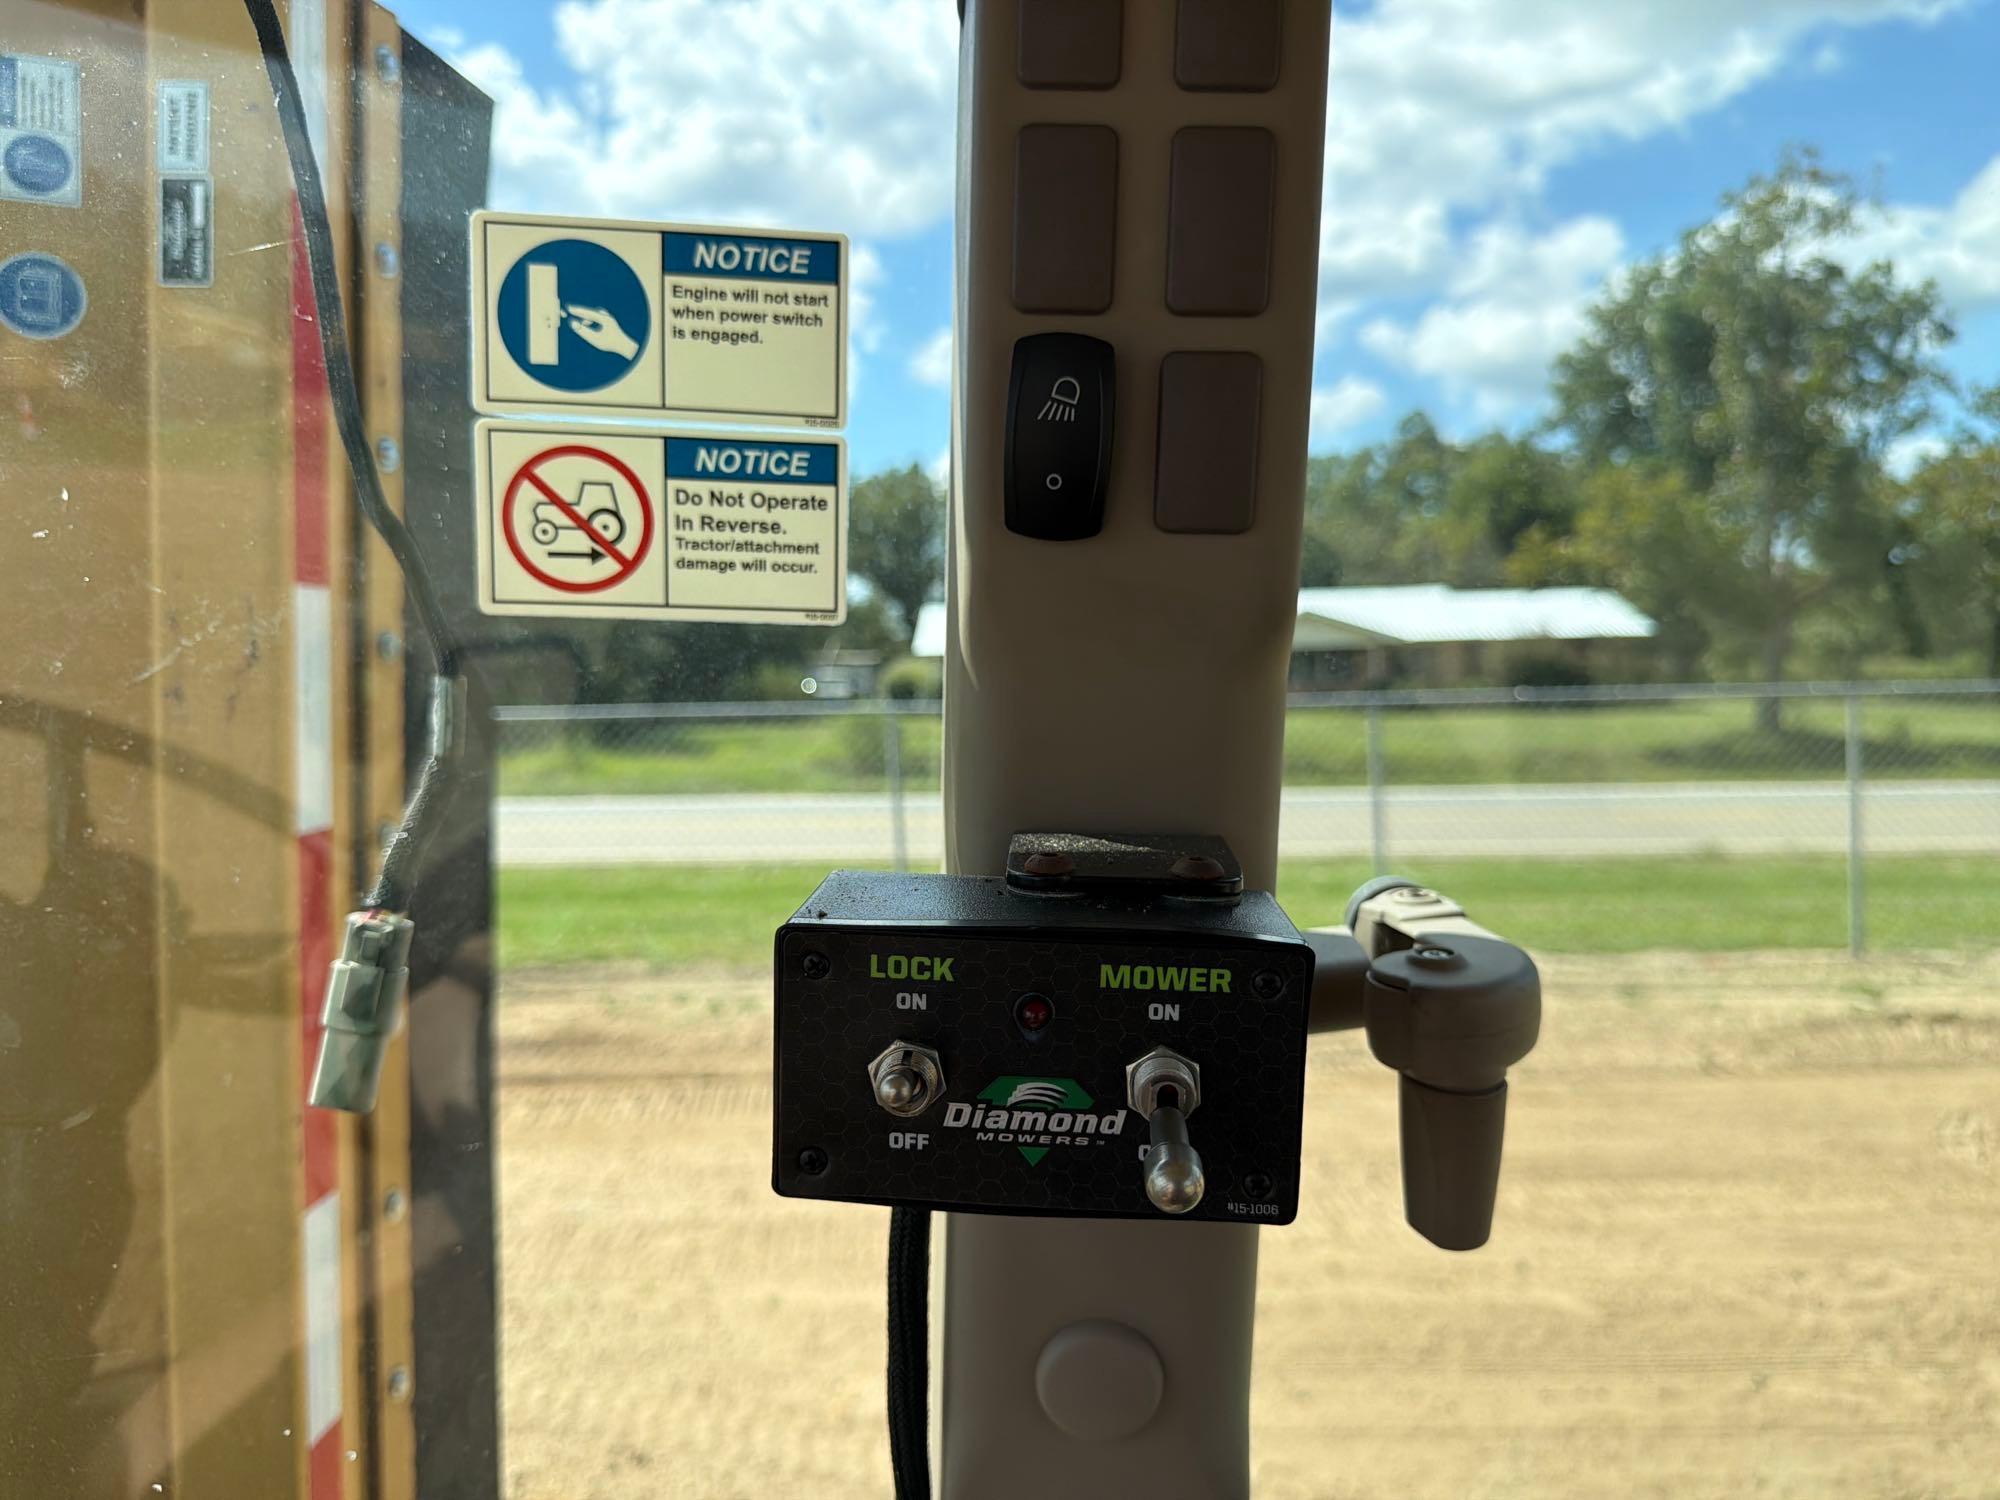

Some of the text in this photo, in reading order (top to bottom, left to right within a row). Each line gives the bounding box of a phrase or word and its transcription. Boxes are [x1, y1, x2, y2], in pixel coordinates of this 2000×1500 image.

[694, 243, 811, 274] NOTICE
[672, 285, 829, 307] Engine will not start
[672, 307, 823, 327] when power switch
[672, 326, 763, 345] is engaged.
[696, 448, 810, 476] NOTICE
[675, 489, 828, 512] Do Not Operate
[675, 515, 787, 535] In Reverse.
[675, 537, 820, 555] Tractor/attachment
[676, 558, 817, 574] damage will occur.
[869, 954, 955, 982] LOCK
[1099, 964, 1232, 993] MOWER
[895, 992, 927, 1011] ON
[1148, 1003, 1180, 1022] ON
[944, 1101, 1127, 1135] Diamond
[888, 1131, 930, 1150] OFF
[976, 1132, 1089, 1146] MOWERS
[1227, 1202, 1280, 1216] #15-1006
